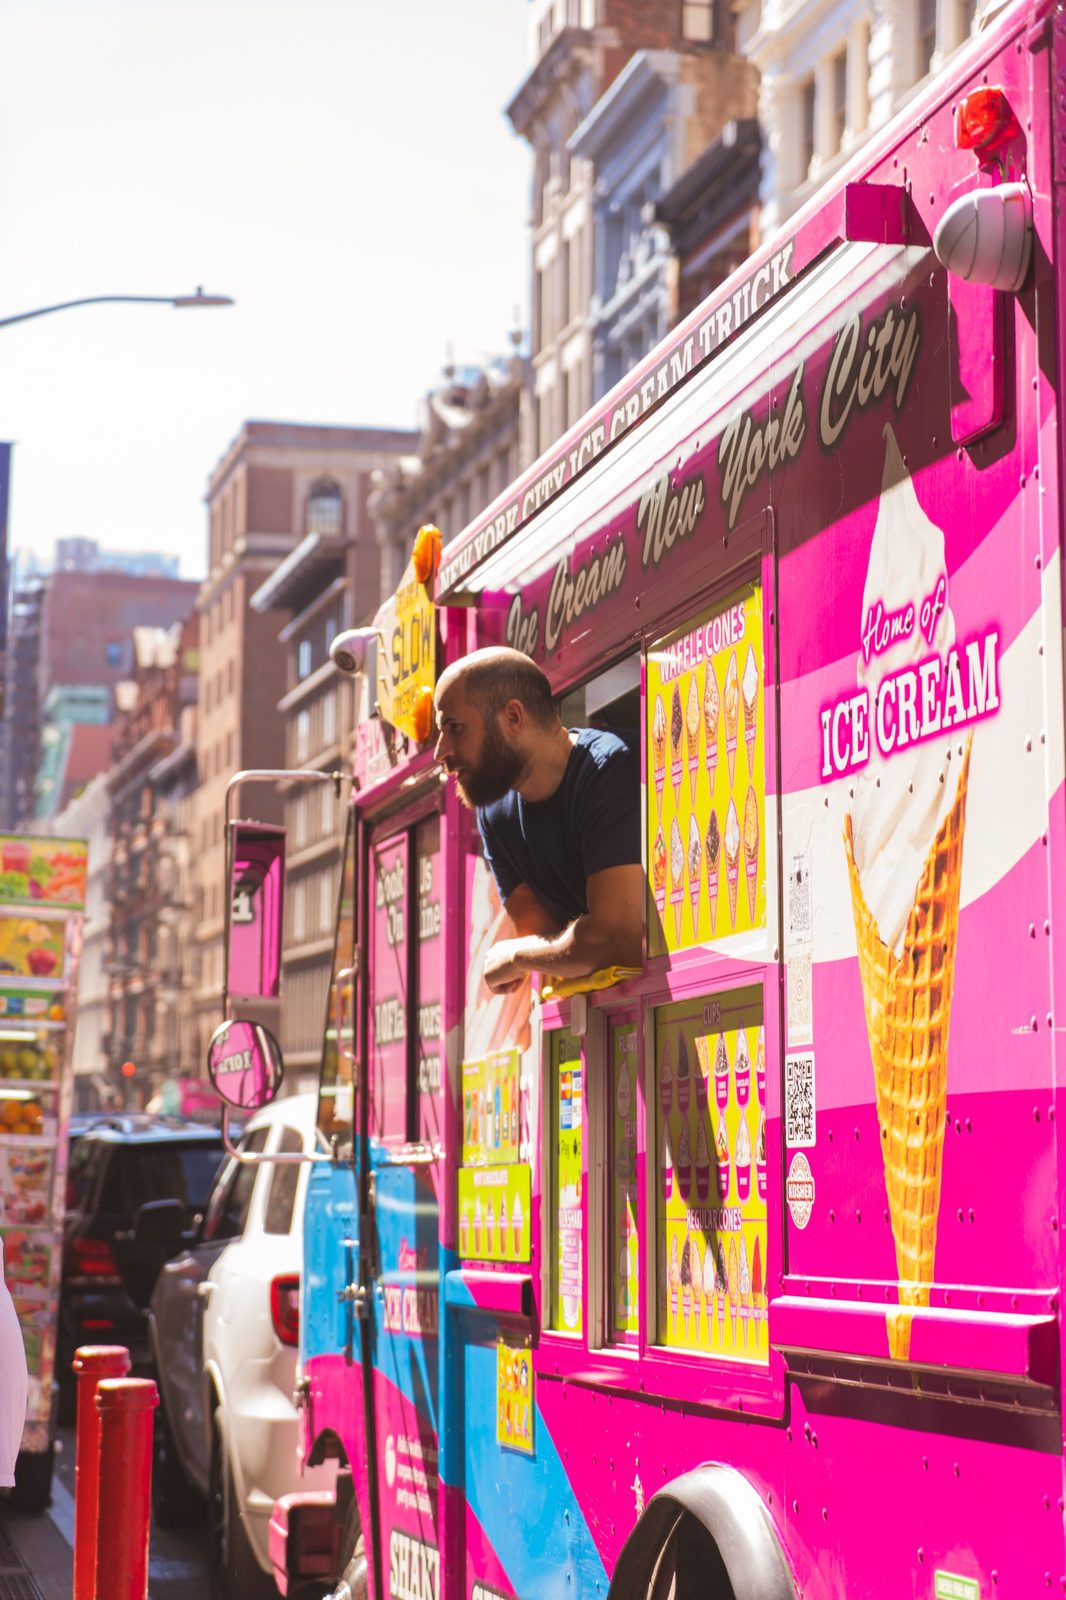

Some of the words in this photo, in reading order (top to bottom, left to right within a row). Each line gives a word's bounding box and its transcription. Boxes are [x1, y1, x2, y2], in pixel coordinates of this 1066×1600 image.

[440, 543, 473, 594] NEW
[474, 503, 518, 561] YORK
[522, 467, 566, 520] CITY
[569, 425, 605, 477] ICE
[610, 337, 696, 441] CREAM
[699, 242, 794, 359] TRUCK
[507, 593, 538, 656] Ice
[546, 554, 628, 650] Cream
[637, 472, 705, 566] New
[718, 361, 807, 530] York
[820, 309, 920, 447] City
[392, 606, 431, 688] SLOW
[660, 628, 703, 683] WAFFLE
[704, 601, 745, 658] CONES
[862, 604, 914, 663] Home
[920, 578, 945, 644] of
[821, 692, 869, 778] ICE
[876, 632, 1000, 754] CREAM
[703, 1002, 721, 1025] CUPS
[687, 1209, 718, 1231] REGULAR
[719, 1208, 742, 1231] CONES
[788, 1183, 814, 1201] KOSHER
